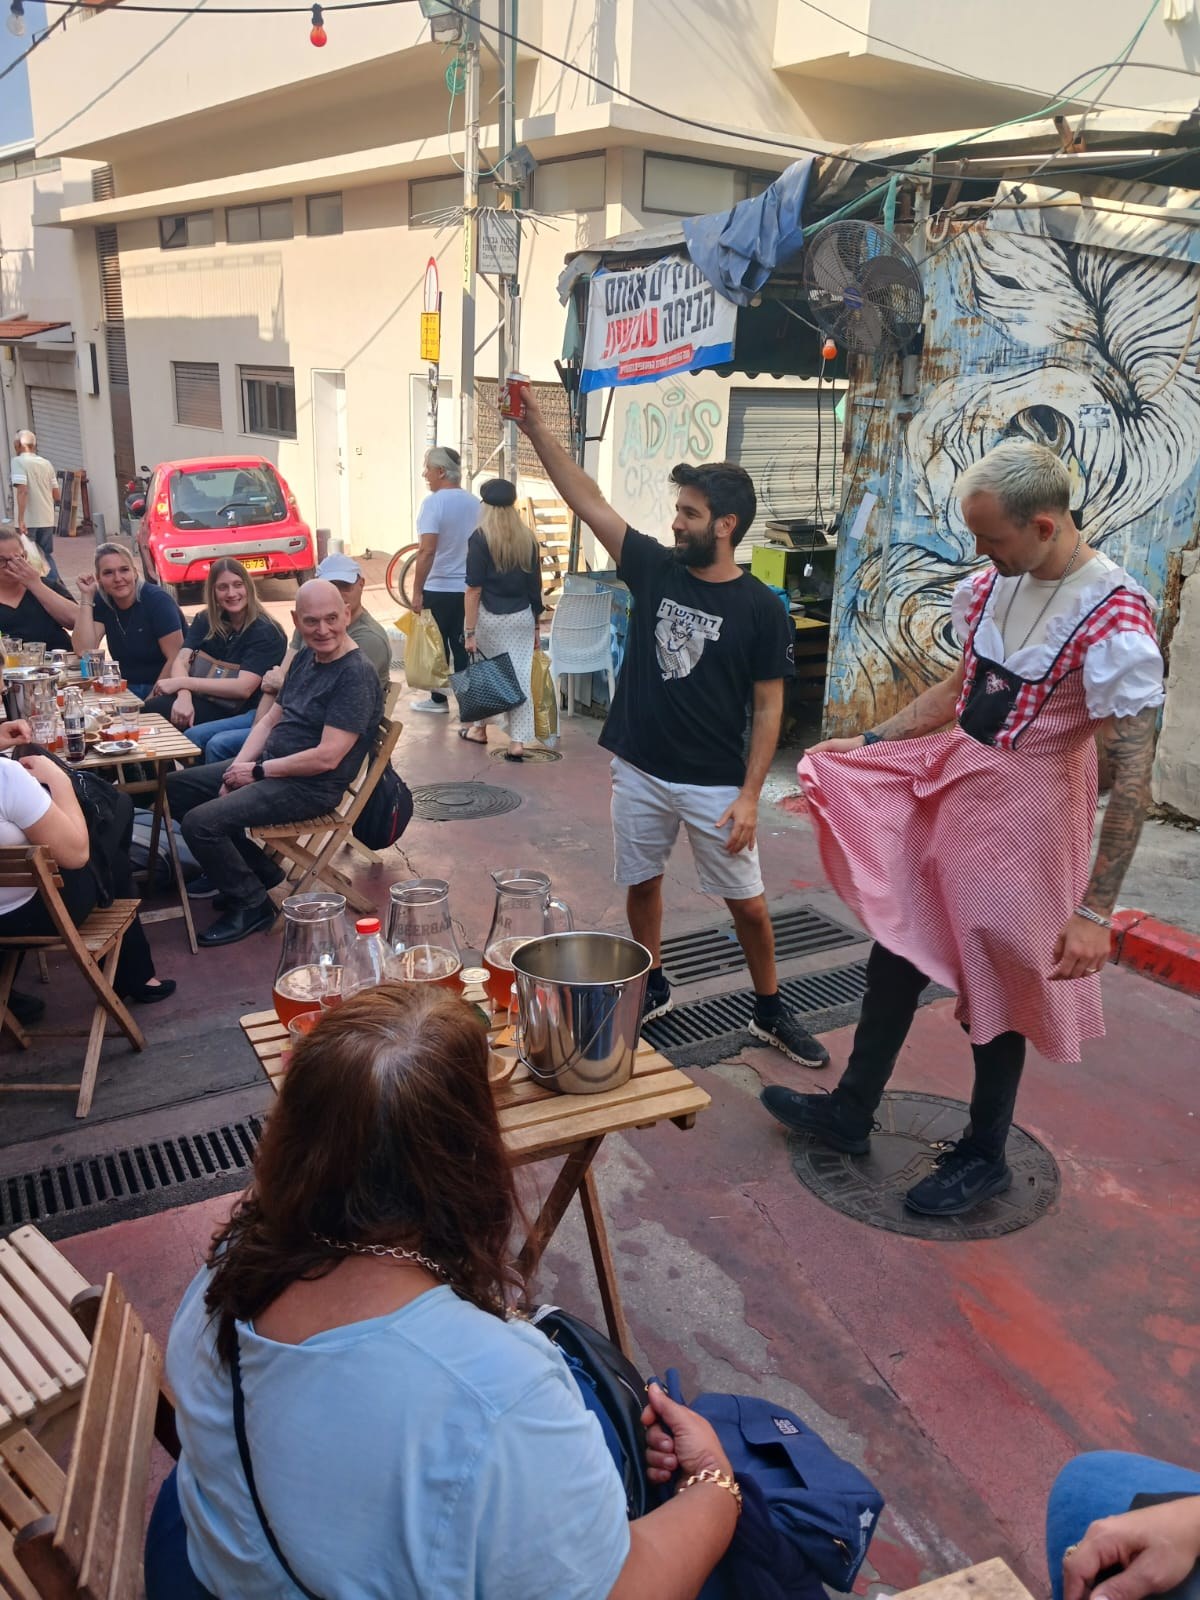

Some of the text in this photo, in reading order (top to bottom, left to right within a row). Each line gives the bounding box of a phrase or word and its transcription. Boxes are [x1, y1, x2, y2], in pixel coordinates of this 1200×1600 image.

[605, 270, 647, 316] אותם
[662, 287, 715, 344] הביתה
[618, 399, 722, 468] ADHS
